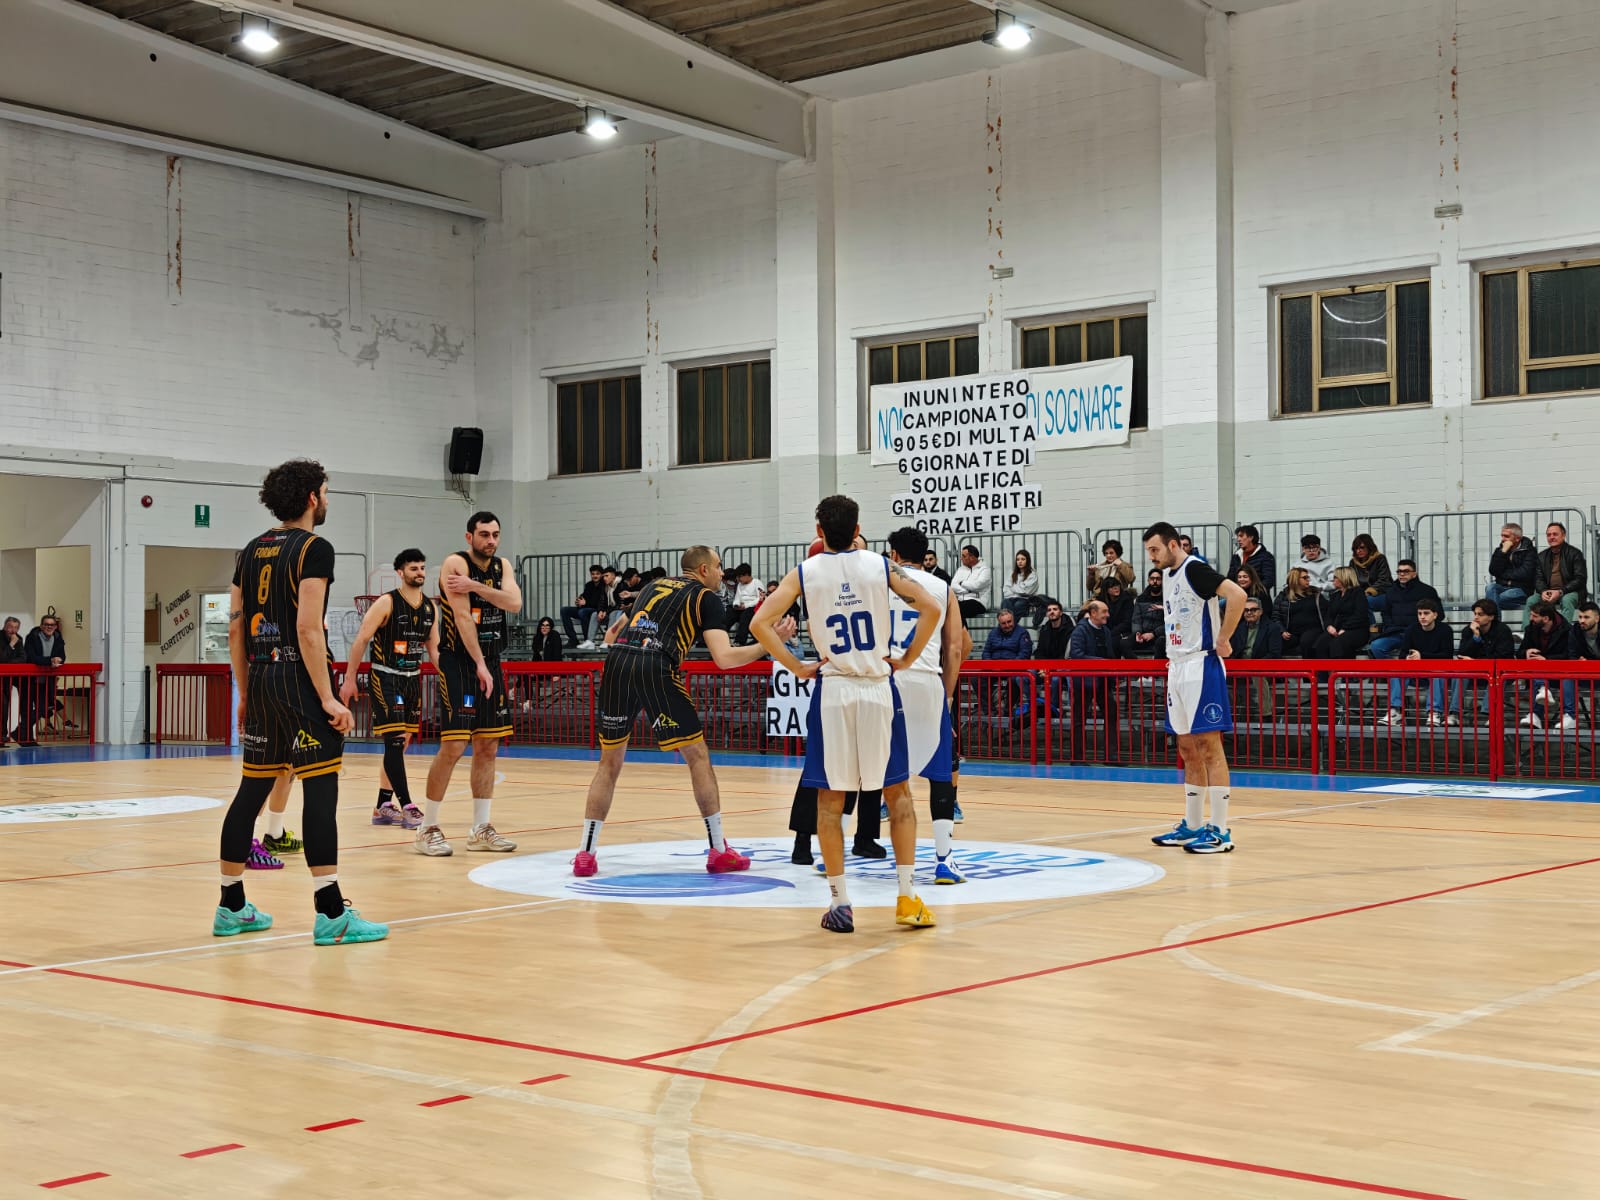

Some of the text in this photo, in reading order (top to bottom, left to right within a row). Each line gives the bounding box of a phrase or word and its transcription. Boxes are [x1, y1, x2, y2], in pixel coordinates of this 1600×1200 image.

[902, 402, 1027, 430] CAMPIONATO
[1044, 383, 1123, 436] SOGNARE
[968, 425, 1036, 446] MULTA
[898, 448, 1030, 473] 6 GIORNATE DI
[892, 490, 1042, 516] GRAZIE ARBITRI
[916, 514, 1021, 535] GRAZIE FIP
[257, 563, 273, 605] 8
[165, 589, 192, 615] LOUNGE
[643, 586, 673, 612] 7
[173, 608, 190, 626] BAR
[160, 621, 195, 656] FORTITUDO
[826, 610, 876, 655] 30
